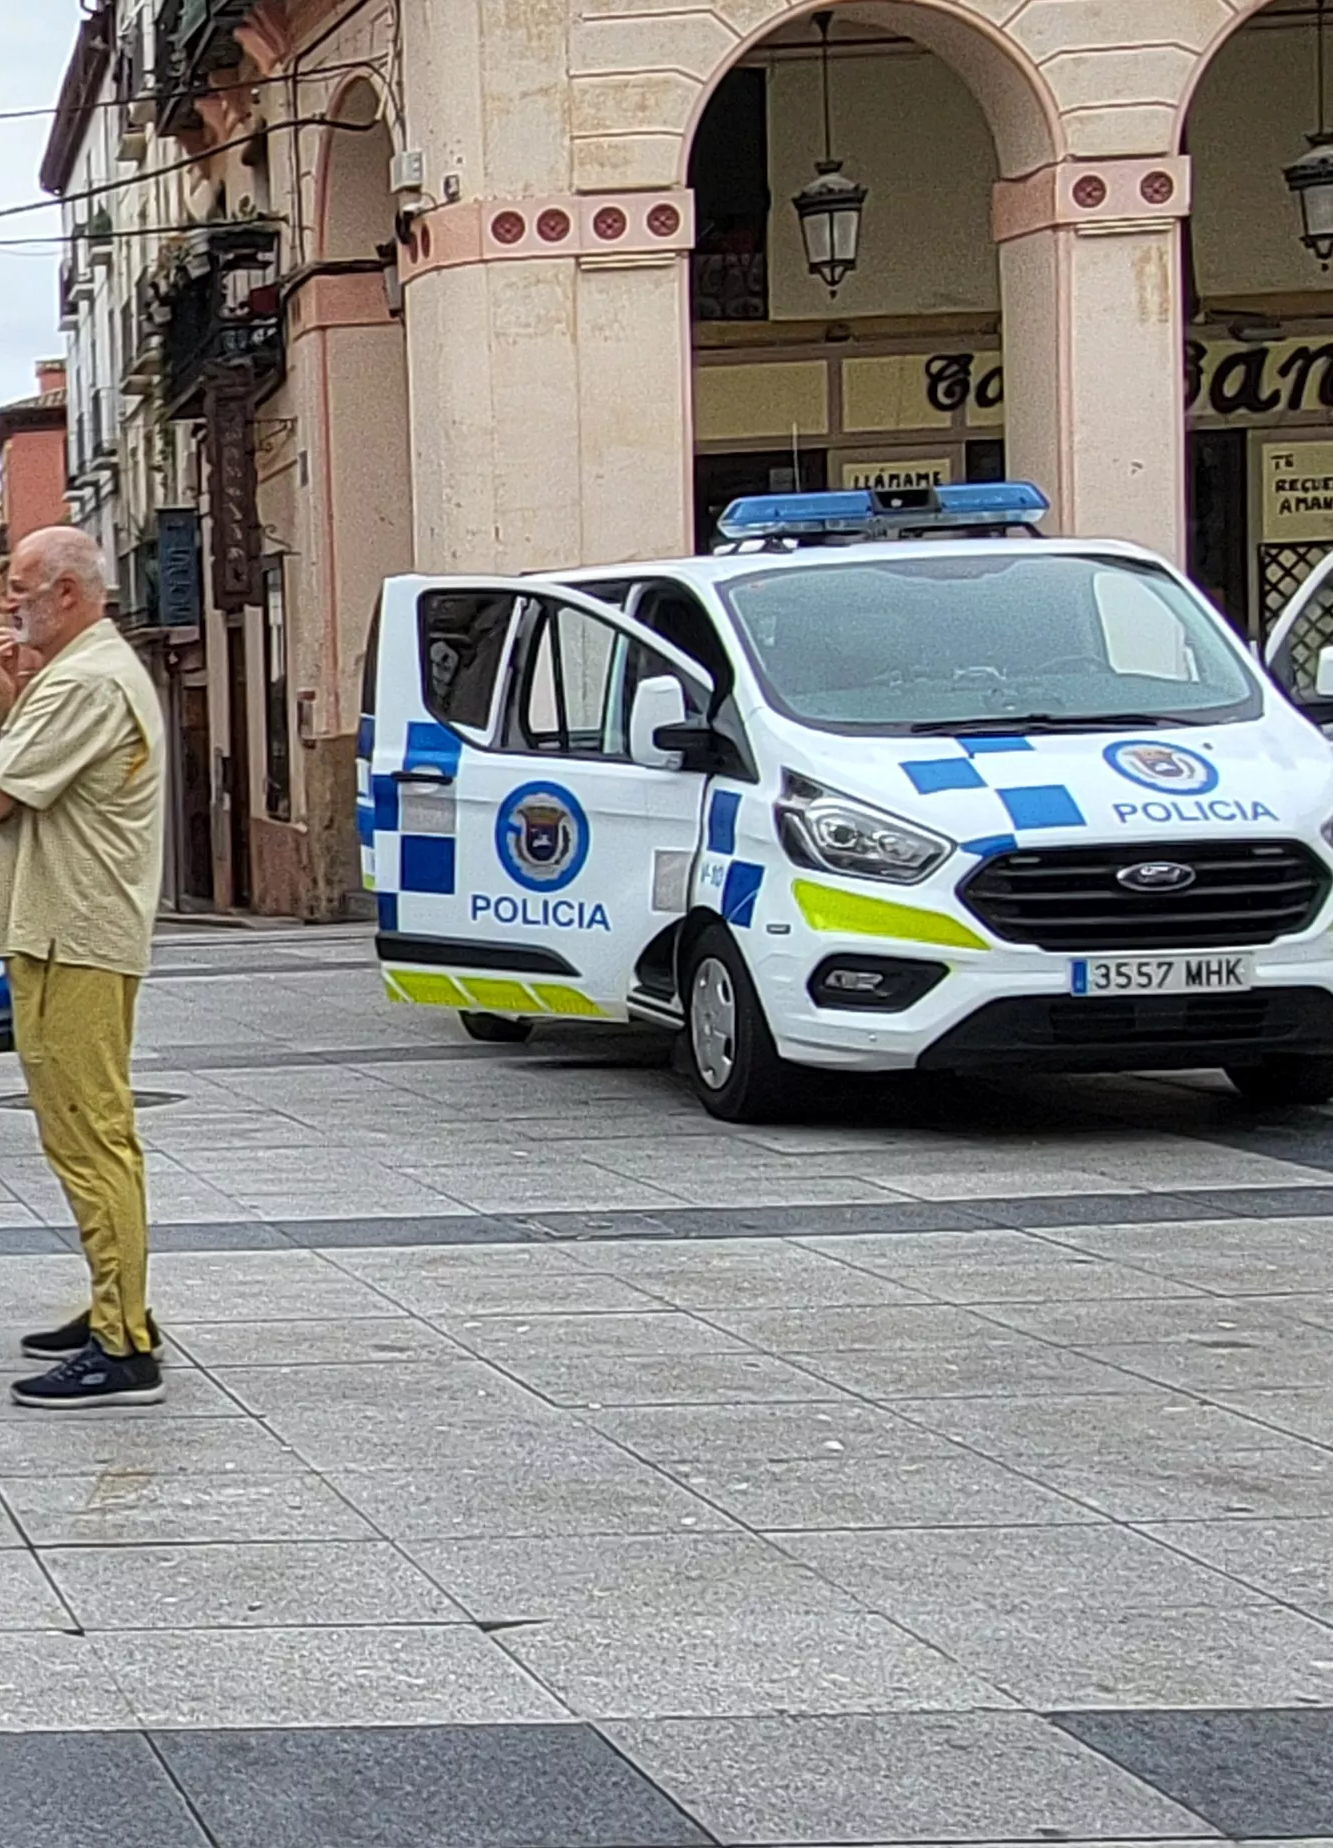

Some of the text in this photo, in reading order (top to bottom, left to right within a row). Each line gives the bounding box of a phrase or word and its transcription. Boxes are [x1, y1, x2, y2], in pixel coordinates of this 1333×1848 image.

[1112, 801, 1280, 823] POLICIA
[470, 894, 612, 932] POLICIA
[1094, 958, 1243, 990] 3557 MHK
